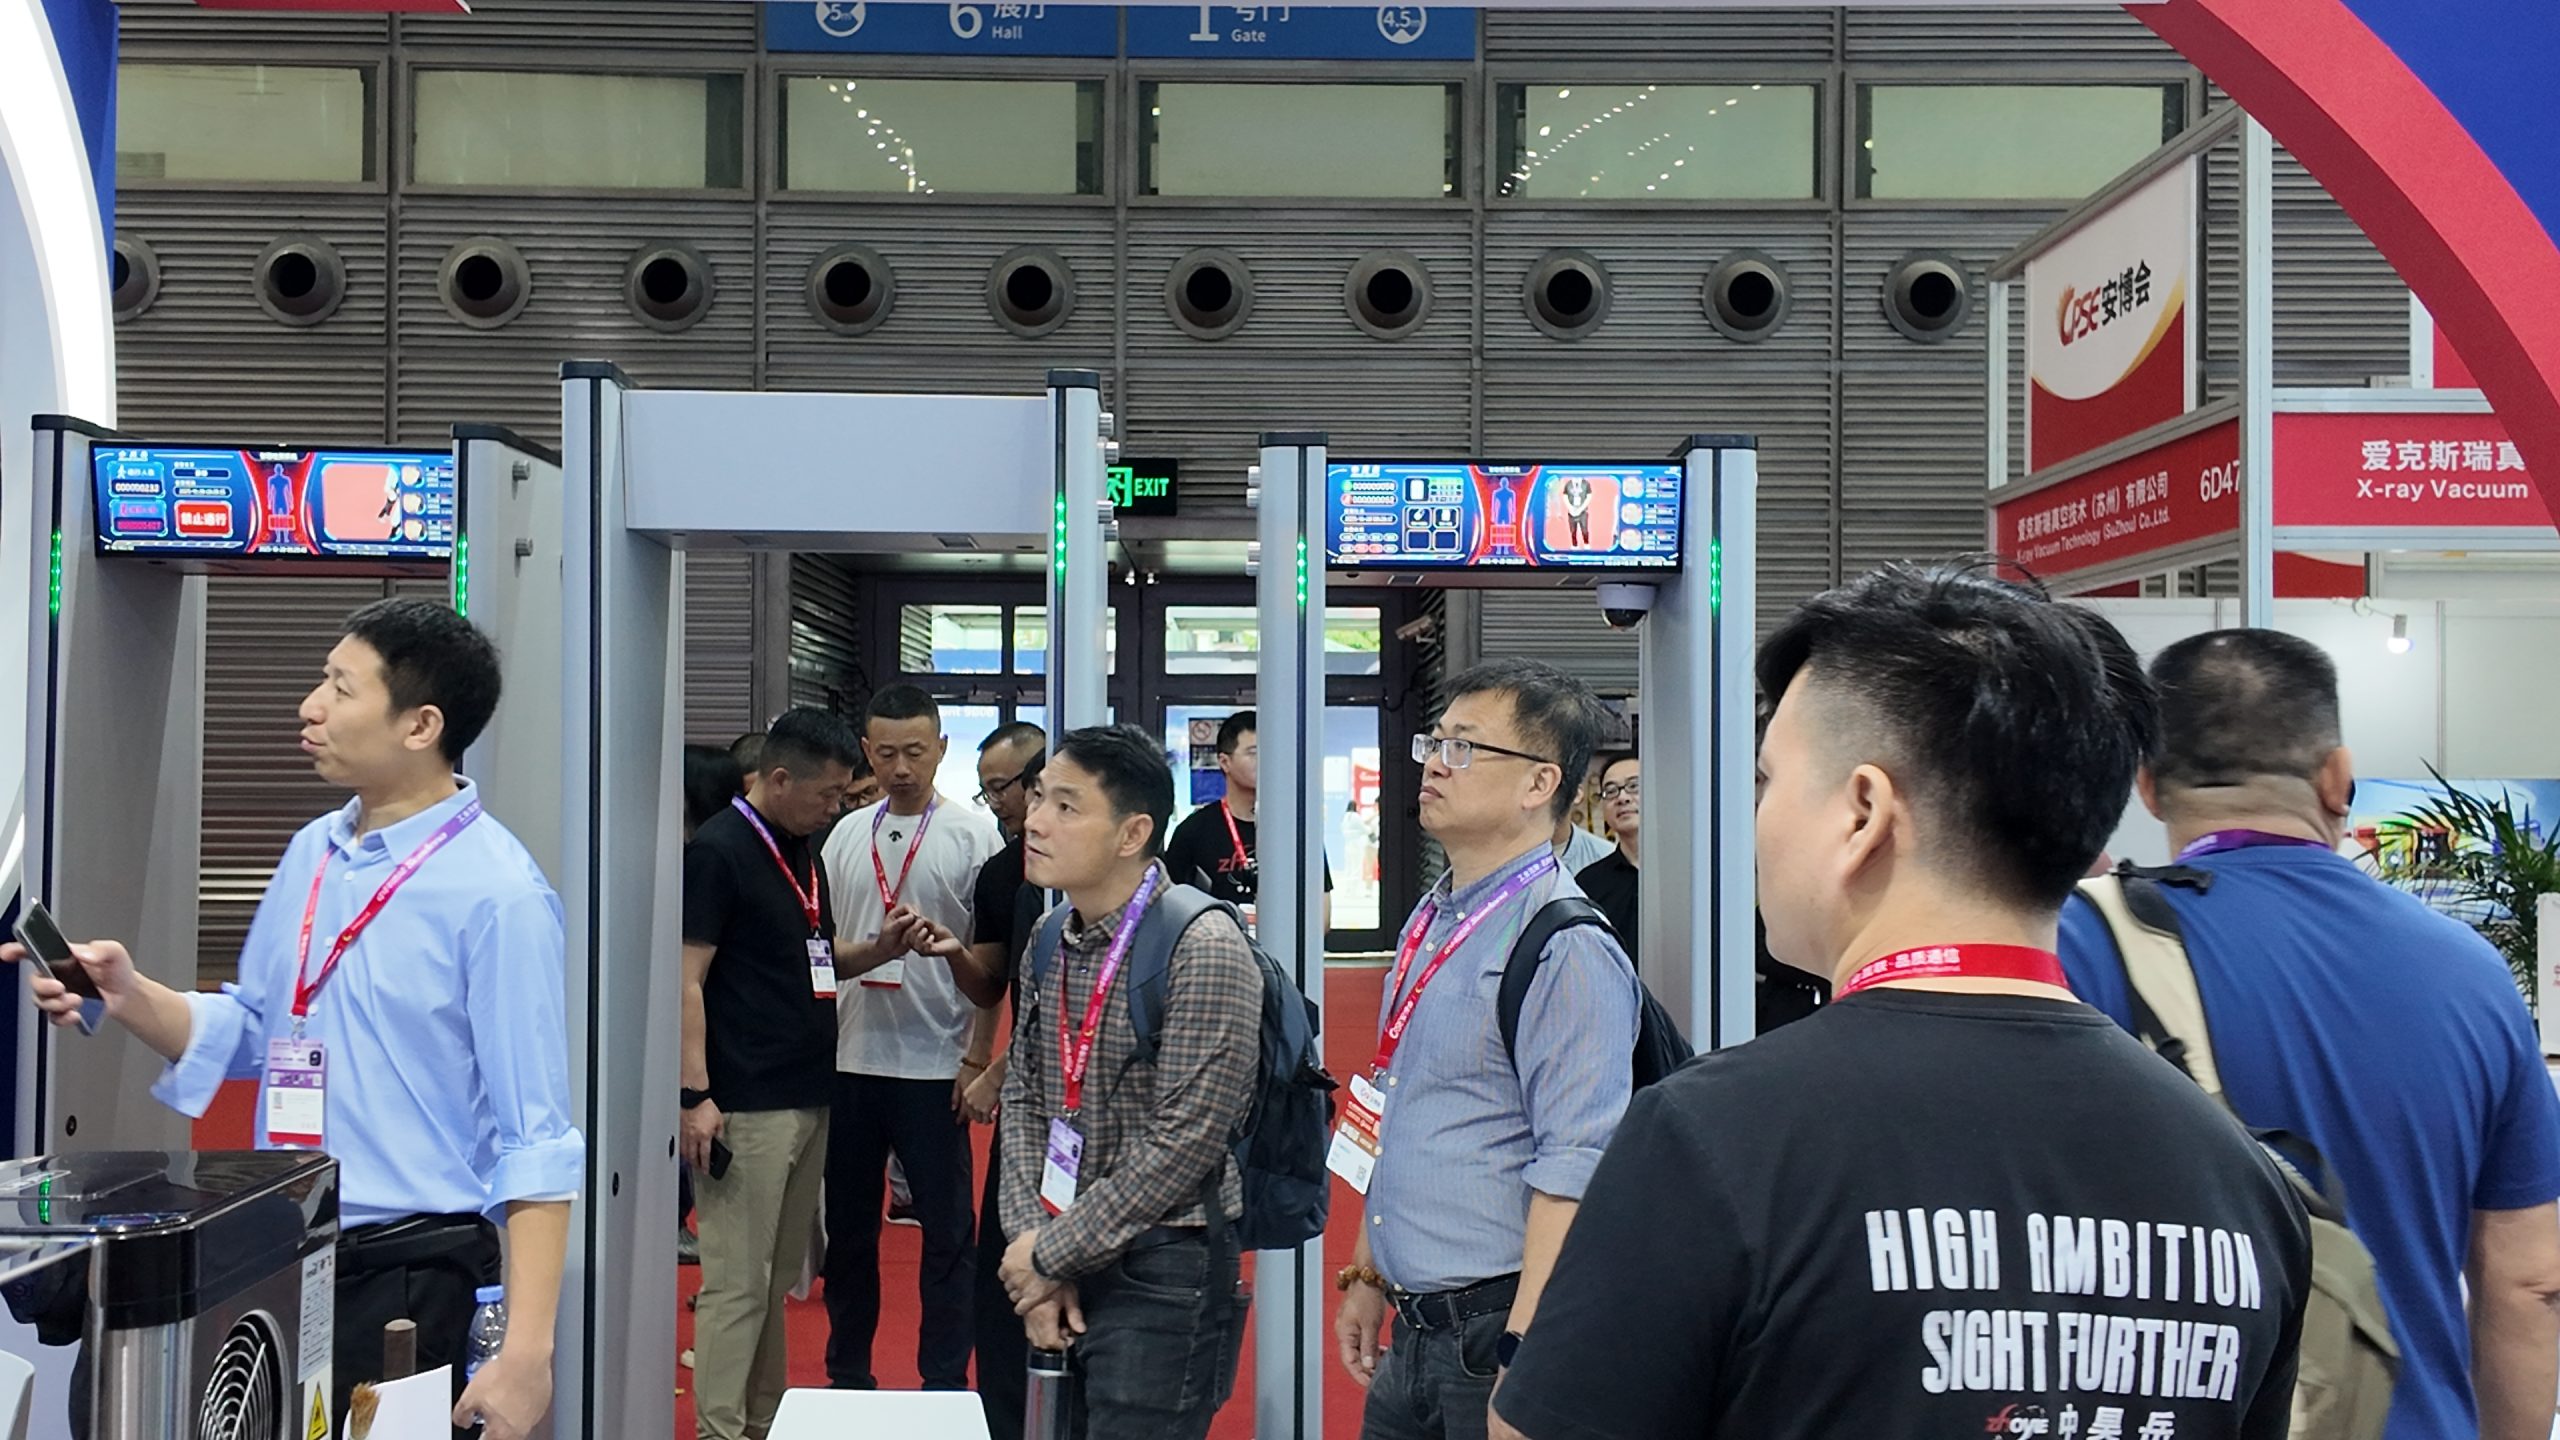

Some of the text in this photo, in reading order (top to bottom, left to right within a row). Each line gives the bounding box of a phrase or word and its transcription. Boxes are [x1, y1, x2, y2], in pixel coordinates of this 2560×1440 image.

[949, 3, 983, 39] 6
[991, 25, 1023, 40] Hall
[1231, 28, 1267, 43] Gate
[2101, 259, 2152, 326] 安博会
[2361, 439, 2526, 472] 爱克斯瑞真
[1134, 477, 1170, 497] EXIT
[2356, 478, 2529, 503] X-ray Vacuum
[2033, 540, 2061, 561] Vacuum
[2061, 528, 2101, 549] Technology
[1865, 1207, 2261, 1310] HIGH AMBITION
[1921, 1309, 2240, 1401] SIGHT FURTHER
